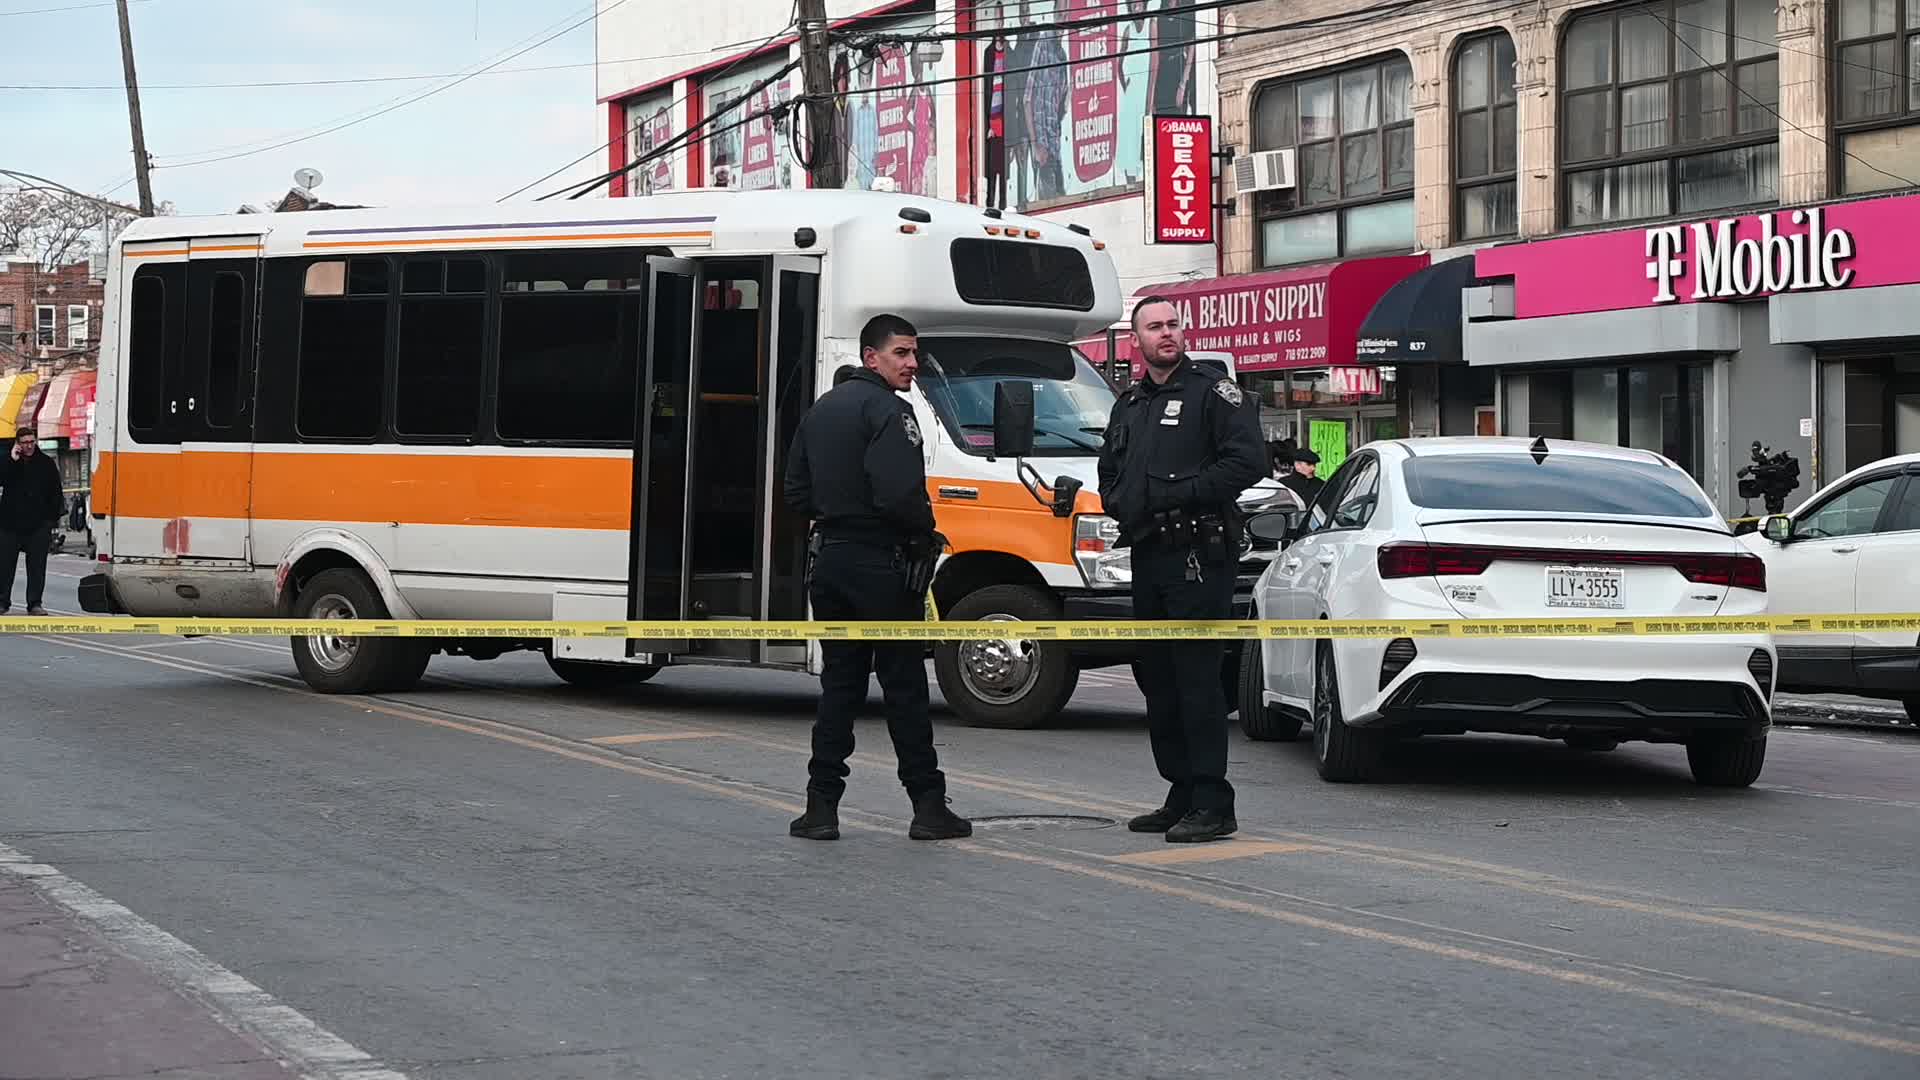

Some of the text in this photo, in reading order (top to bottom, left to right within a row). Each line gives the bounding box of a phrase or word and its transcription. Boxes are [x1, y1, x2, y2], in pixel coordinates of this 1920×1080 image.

[1075, 61, 1113, 89] CLOTHING
[1088, 89, 1100, 113] at
[1075, 114, 1113, 141] DISCOUNT
[1079, 140, 1110, 166] PRICES!
[1171, 133, 1196, 226] BEAUTY
[1162, 228, 1206, 238] SUPPLY
[1691, 208, 1851, 299] Mobile
[1199, 290, 1260, 329] BEAUTY
[1264, 282, 1326, 323] SUPPLY
[1195, 335, 1231, 350] HUMAN
[1235, 333, 1259, 347] HAIR
[1262, 332, 1270, 345] &
[1274, 328, 1302, 344] WIGS
[1336, 367, 1377, 393] ATM
